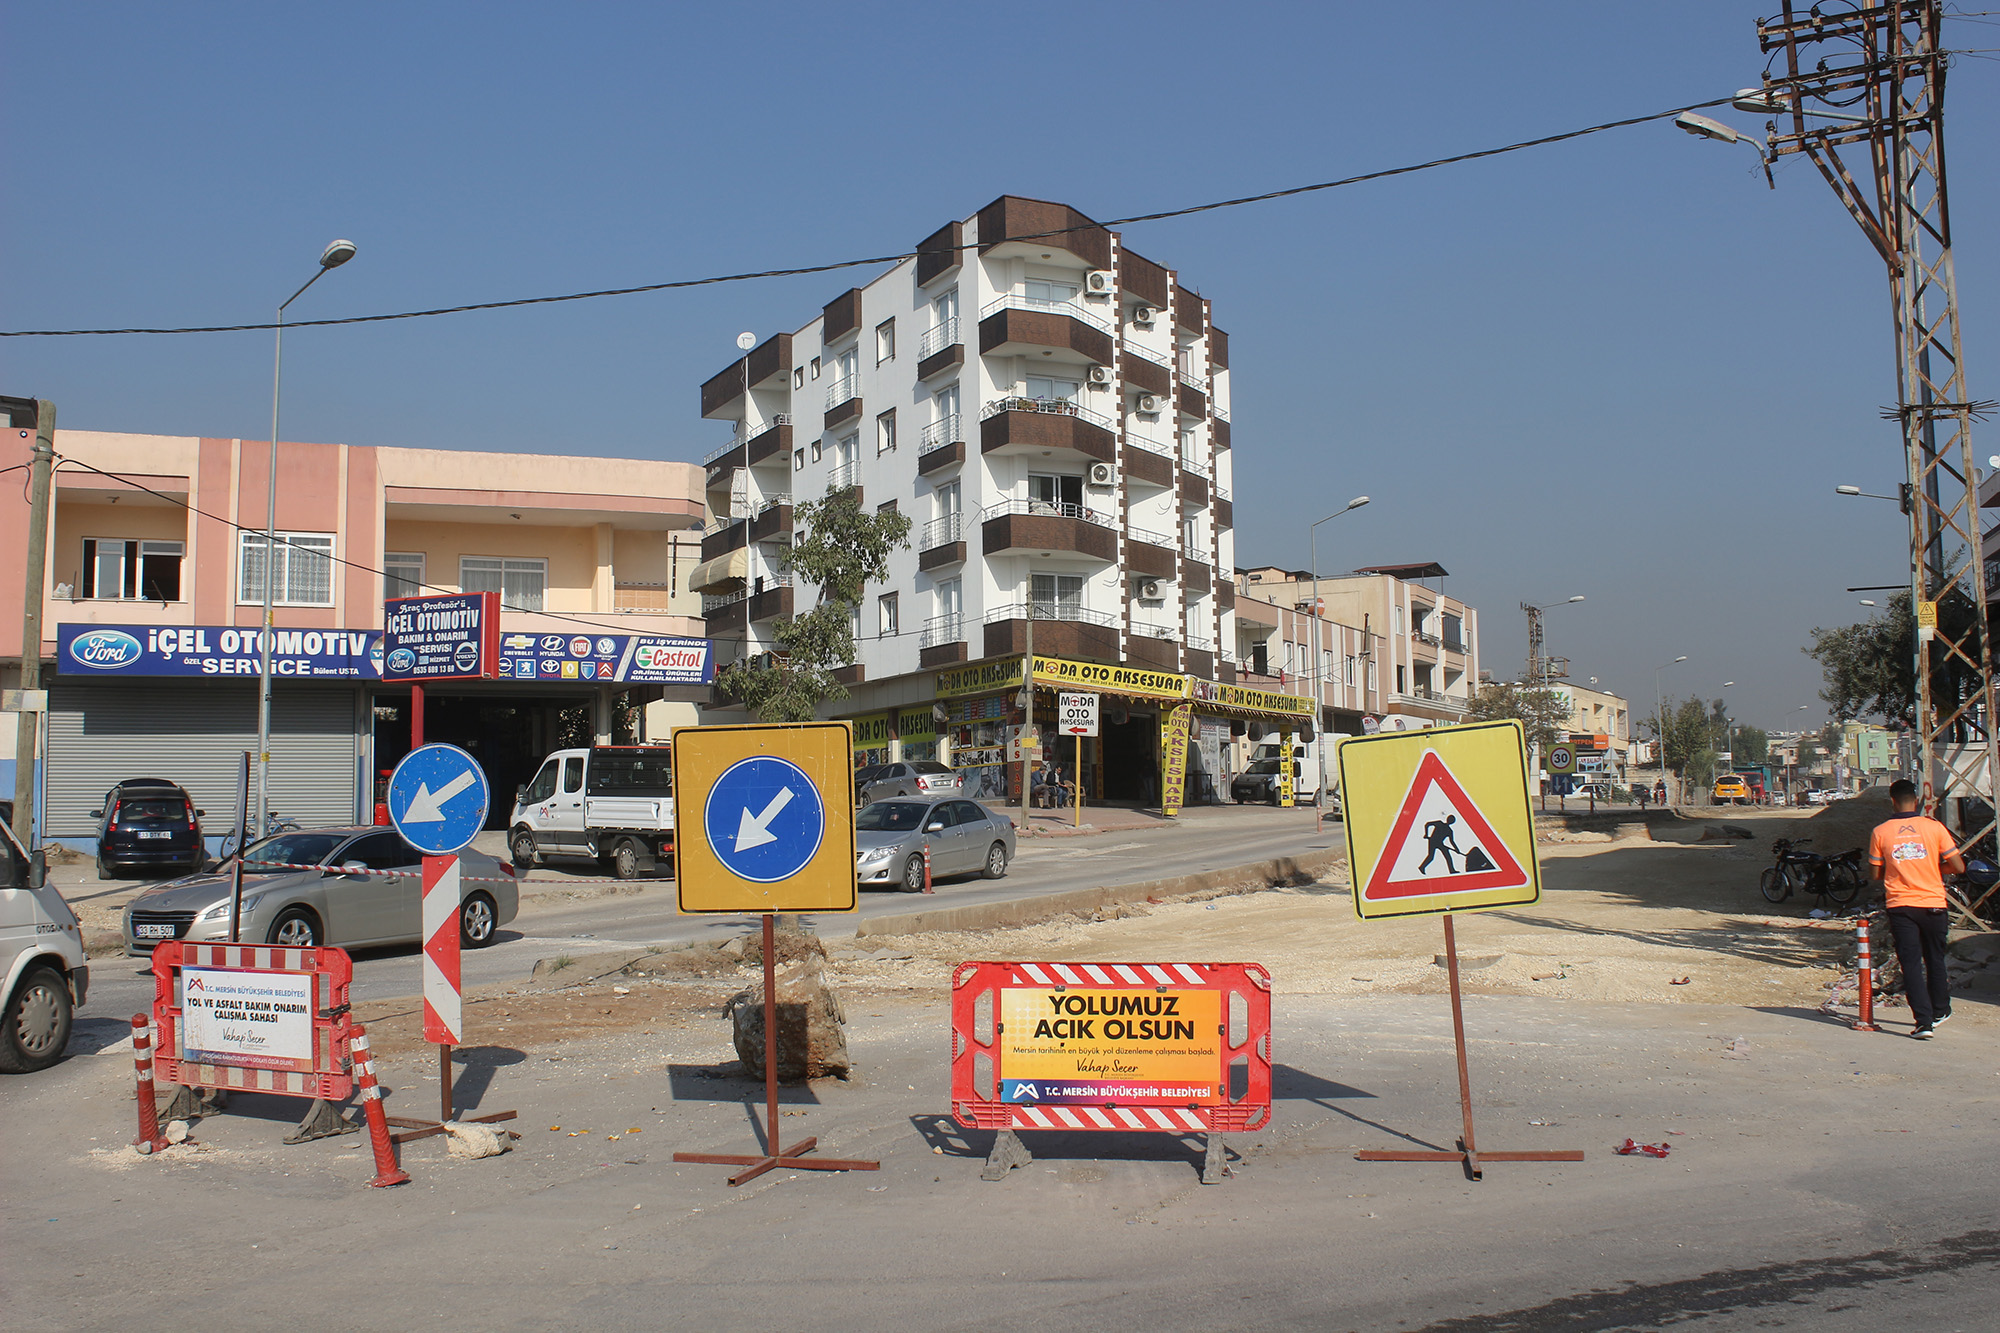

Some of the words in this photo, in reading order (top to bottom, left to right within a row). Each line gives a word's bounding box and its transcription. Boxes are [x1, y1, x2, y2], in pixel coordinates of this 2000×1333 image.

[398, 634, 425, 644] BAKIM
[426, 633, 433, 642] &
[434, 631, 468, 641] ONARIM
[656, 638, 708, 646] İŞYERİNDE
[84, 634, 128, 662] Ford
[574, 643, 586, 652] FIAT
[184, 656, 201, 664] ÖZEL
[392, 652, 410, 668] Ford
[653, 649, 701, 667] Castrol
[963, 668, 978, 686] OTO
[982, 660, 1021, 684] AKSESUAR
[1082, 666, 1110, 680] OTO
[1114, 670, 1183, 691] AKSESUAR
[1246, 692, 1262, 706] OTO
[1264, 694, 1298, 711] AKSESUAR
[1067, 709, 1089, 719] OTO
[901, 712, 936, 736] AKSESUA
[1171, 718, 1188, 728] OTO
[1166, 728, 1185, 803] AKSESUAR
[1554, 754, 1568, 764] 30
[36, 924, 64, 934] OTOSAN
[139, 926, 148, 934] 33
[150, 926, 158, 934] RH
[161, 926, 174, 935] 507
[216, 985, 236, 994] MERSİN
[238, 986, 273, 996] BÜYÜKŞEHİR
[274, 989, 306, 998] BELEDİYESİ
[187, 998, 201, 1007] YOL
[204, 999, 213, 1008] VE
[216, 999, 242, 1009] ASFALT
[245, 1001, 271, 1011] BAKIM
[274, 1003, 307, 1014] ONARIM
[1048, 996, 1179, 1016] YOLUMUZ
[214, 1010, 247, 1022] ÇALIŞMA
[250, 1012, 278, 1023] SAHASI
[1034, 1019, 1095, 1047] AÇIK
[1104, 1020, 1194, 1040] OLSUN
[1079, 1047, 1100, 1056] büyük
[1103, 1047, 1114, 1056] yol
[1116, 1047, 1153, 1055] düzenleme
[1155, 1048, 1186, 1057] çalışması
[1188, 1048, 1215, 1057] başladı.
[1077, 1059, 1109, 1078] Vahap
[1045, 1087, 1060, 1096] T.C.
[1062, 1085, 1098, 1096] MERSİN
[1100, 1086, 1158, 1099] BÜYÜKŞEHİR
[1162, 1086, 1210, 1098] BELEDİYESİ
